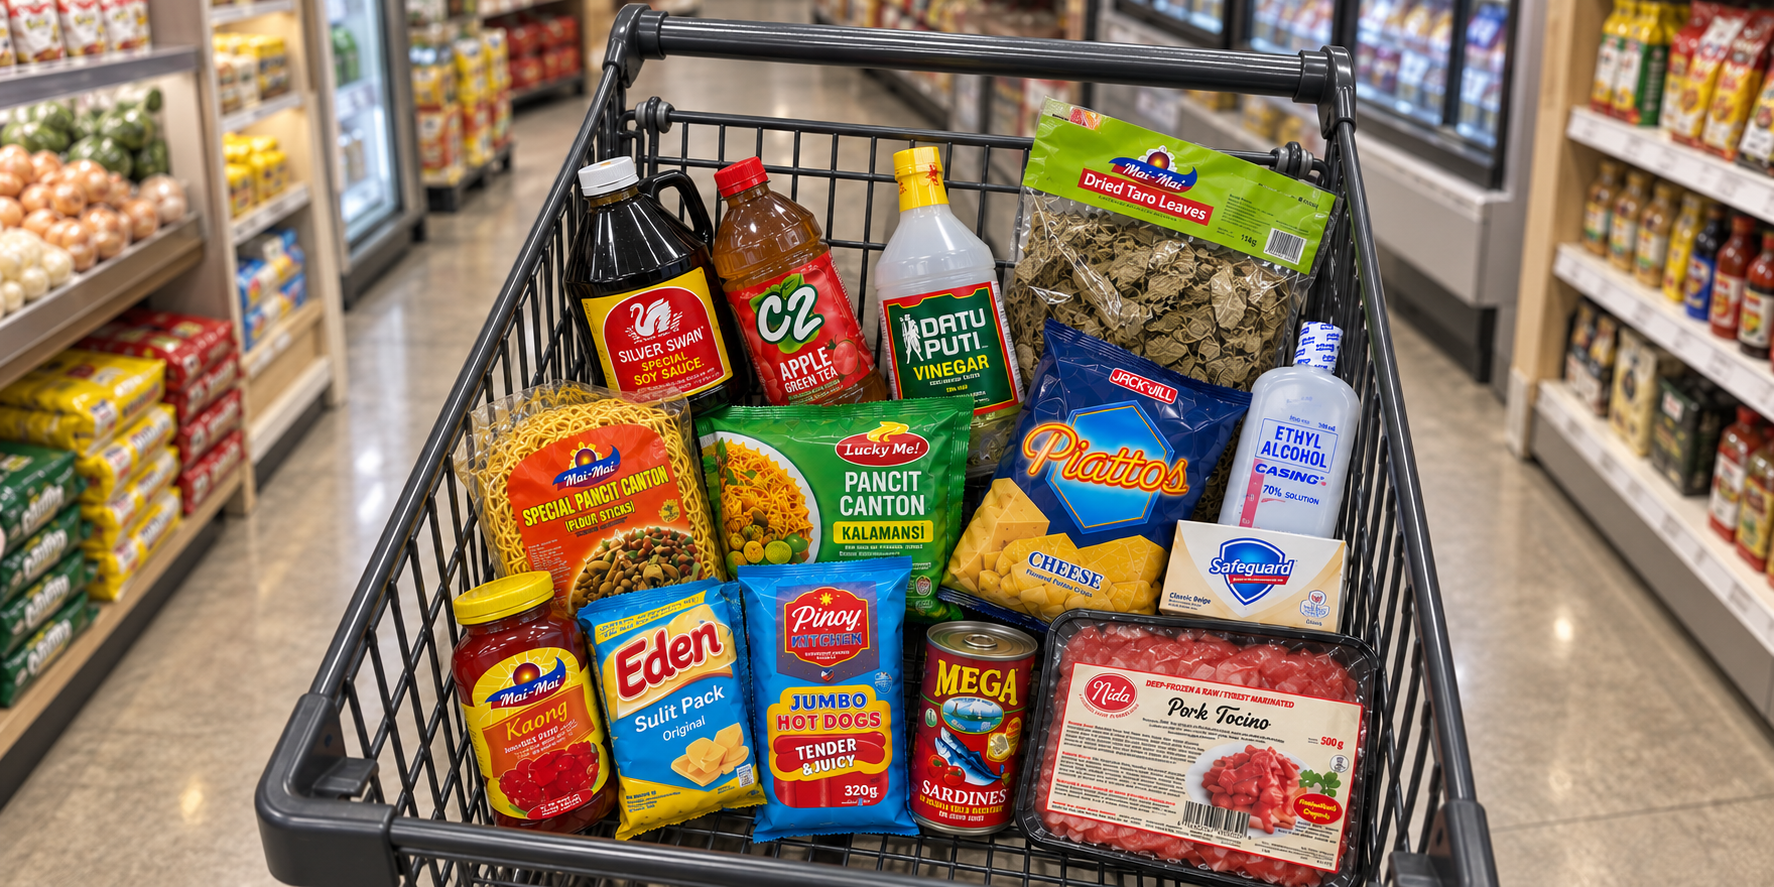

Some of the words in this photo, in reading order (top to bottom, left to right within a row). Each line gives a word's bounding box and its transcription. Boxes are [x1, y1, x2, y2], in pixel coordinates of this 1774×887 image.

[1123, 162, 1185, 191] Mai-Mai
[1083, 172, 1123, 196] Dried
[1126, 184, 1156, 206] Taro
[1158, 192, 1207, 221] Leaves
[757, 286, 824, 343] C2
[920, 308, 986, 338] DATU
[618, 342, 661, 363] SILVER
[667, 328, 703, 353] SWAN
[924, 331, 981, 360] PUTI
[641, 351, 688, 371] SPECIAL
[779, 346, 832, 381] APPLE
[912, 354, 990, 381] VINEGAR
[634, 371, 657, 386] SOY
[784, 374, 818, 394] GREEN
[818, 365, 838, 383] TEA
[843, 443, 889, 458] Lucky
[892, 441, 920, 455] Me!
[1275, 425, 1322, 450] ETHYL
[1022, 422, 1189, 496] Piattos
[1260, 440, 1327, 469] ALCOHOL
[564, 461, 615, 487] Mai-Mai
[844, 471, 922, 493] PANCIT
[1255, 463, 1320, 485] CASING
[522, 499, 576, 527] SPECIAL
[574, 480, 620, 512] PANCIT
[620, 465, 670, 496] CANTON
[839, 494, 925, 516] CANTON
[1263, 484, 1282, 497] 70%
[1285, 491, 1319, 505] SOLUTION
[564, 512, 599, 533] (FLOUR
[599, 500, 635, 522] STICKS)
[841, 523, 925, 541] KALAMANSI
[1028, 551, 1104, 591] CHEESE
[1209, 559, 1296, 577] Safeguard
[791, 605, 861, 634] Pinoy
[615, 621, 724, 701] Eden
[500, 674, 561, 707] Mai-Mai
[933, 659, 1018, 706] MEGA
[1092, 680, 1130, 705] Nida
[634, 704, 678, 733] Sulit
[682, 685, 726, 715] Pack
[790, 692, 868, 711] JUMBO
[1167, 697, 1208, 721] Pork
[1216, 705, 1269, 730] Tocino
[505, 701, 568, 741] Kaong
[662, 716, 706, 742] Original
[776, 714, 818, 732] HOT
[823, 711, 881, 731] DOGS
[795, 738, 857, 761] TENDER
[1320, 736, 1337, 747] 500
[1337, 739, 1344, 750] g
[844, 784, 878, 798] 320g
[922, 780, 1007, 806] SARDINES
